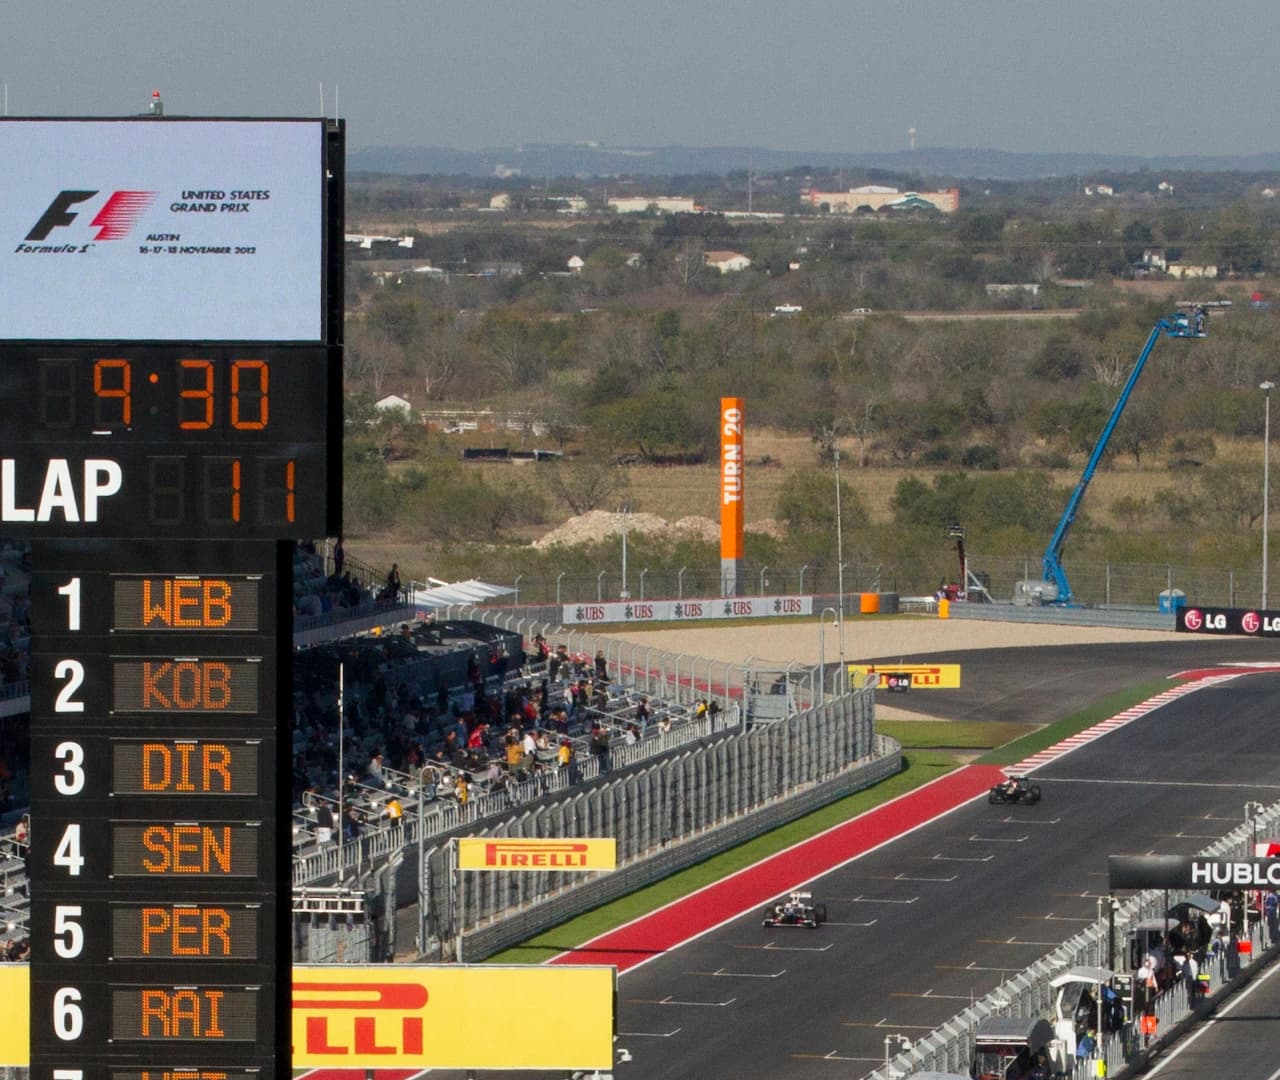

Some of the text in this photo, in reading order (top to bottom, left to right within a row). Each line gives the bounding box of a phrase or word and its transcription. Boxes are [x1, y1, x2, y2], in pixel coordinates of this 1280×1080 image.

[181, 190, 271, 201] UNITED STATES
[170, 202, 250, 213] GRAND PRIX
[145, 233, 181, 242] AUSTIN
[14, 243, 75, 255] Formula
[179, 245, 232, 255] NOVEMBER
[234, 246, 257, 255] 2012
[724, 407, 742, 505] TURN 20
[1, 458, 122, 522] LAP
[59, 578, 231, 630] 1 WEB
[684, 603, 703, 616] UBS
[733, 601, 752, 615] UBS
[783, 599, 801, 613] UBS
[585, 607, 605, 620] UBS
[634, 605, 654, 619] UBS
[1205, 614, 1227, 629] LG
[55, 660, 230, 712] 2 KOB
[55, 742, 231, 795] 3 DIR
[54, 824, 230, 875] 4 SEN
[485, 843, 588, 866] PIRELLI
[55, 906, 230, 958] 5 PER
[54, 988, 224, 1040] 6 RAI
